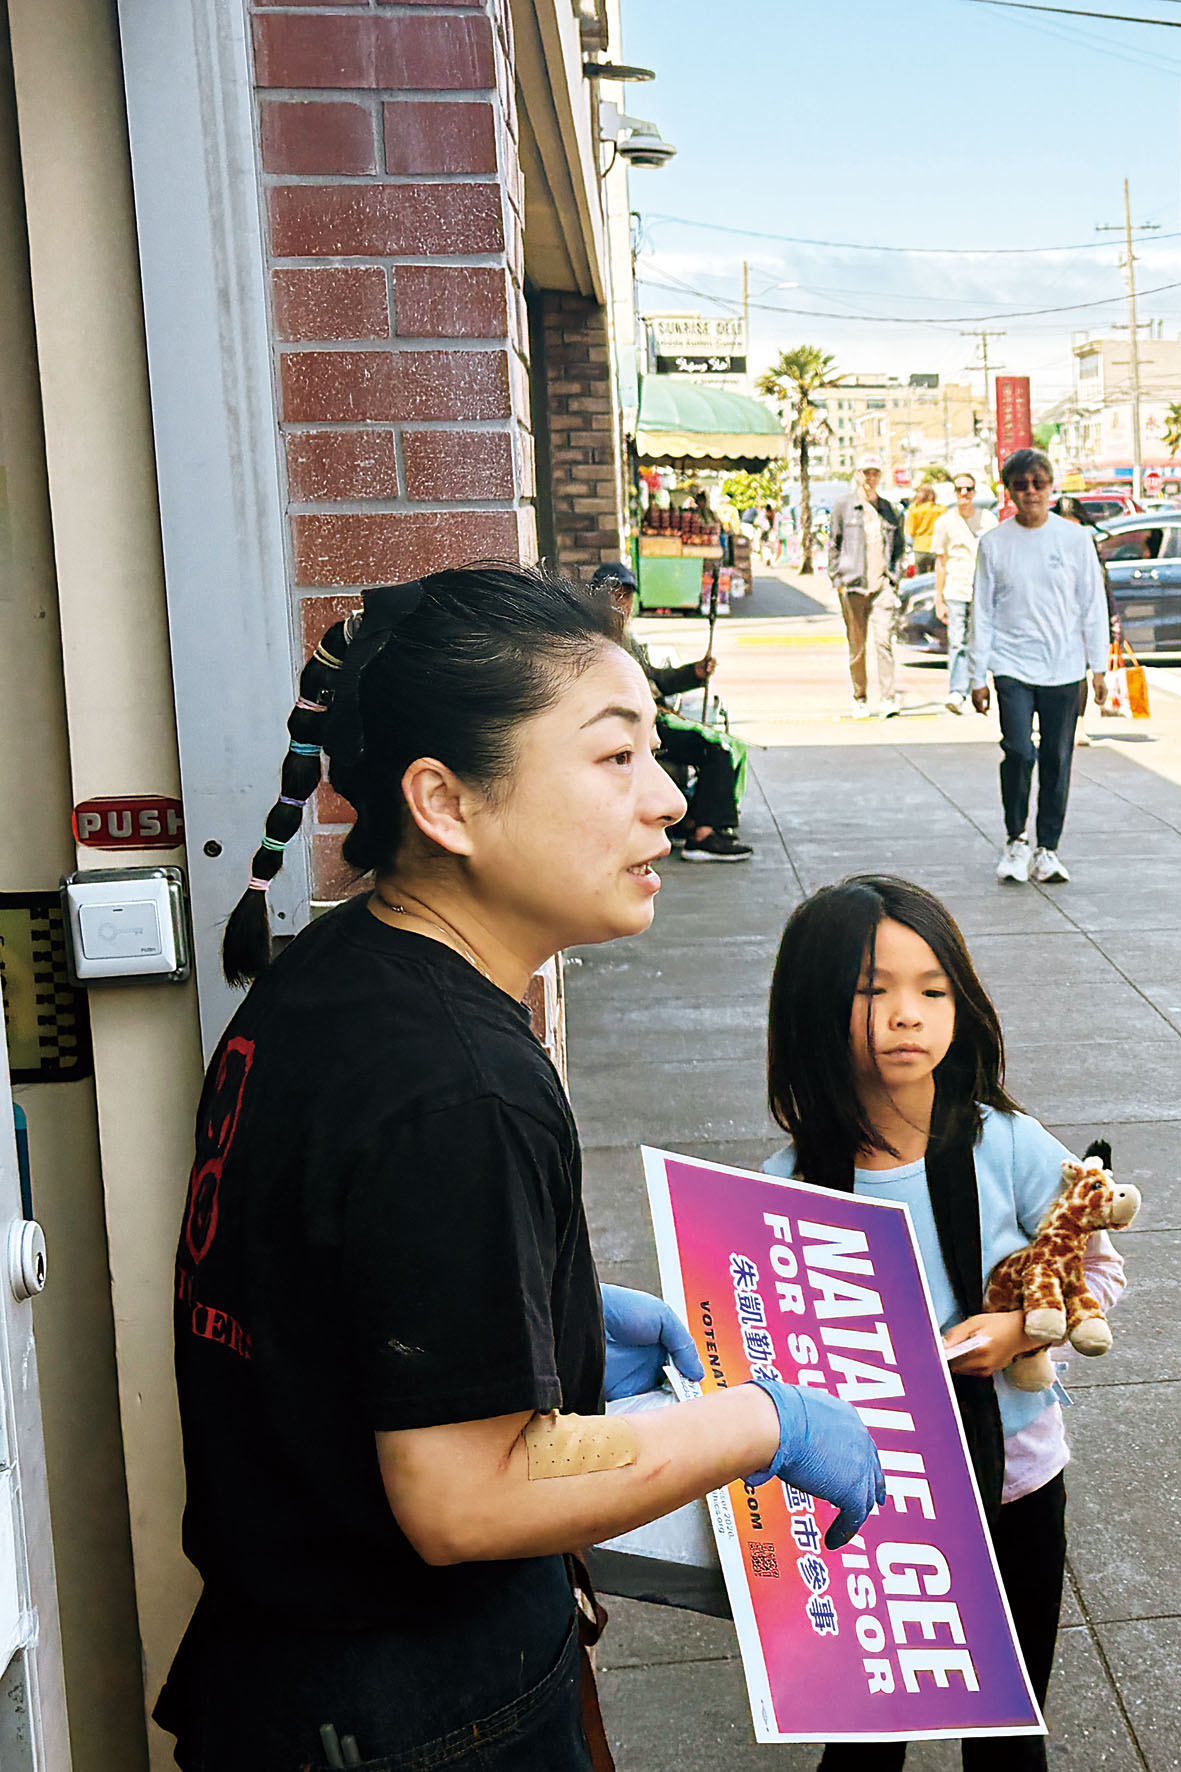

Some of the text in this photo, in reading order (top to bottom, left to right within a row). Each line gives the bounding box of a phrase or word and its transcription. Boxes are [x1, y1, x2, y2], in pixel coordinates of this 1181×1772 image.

[658, 322, 709, 335] SUNRISE
[763, 1211, 804, 1315] FOR
[875, 1541, 980, 1692] GEE
